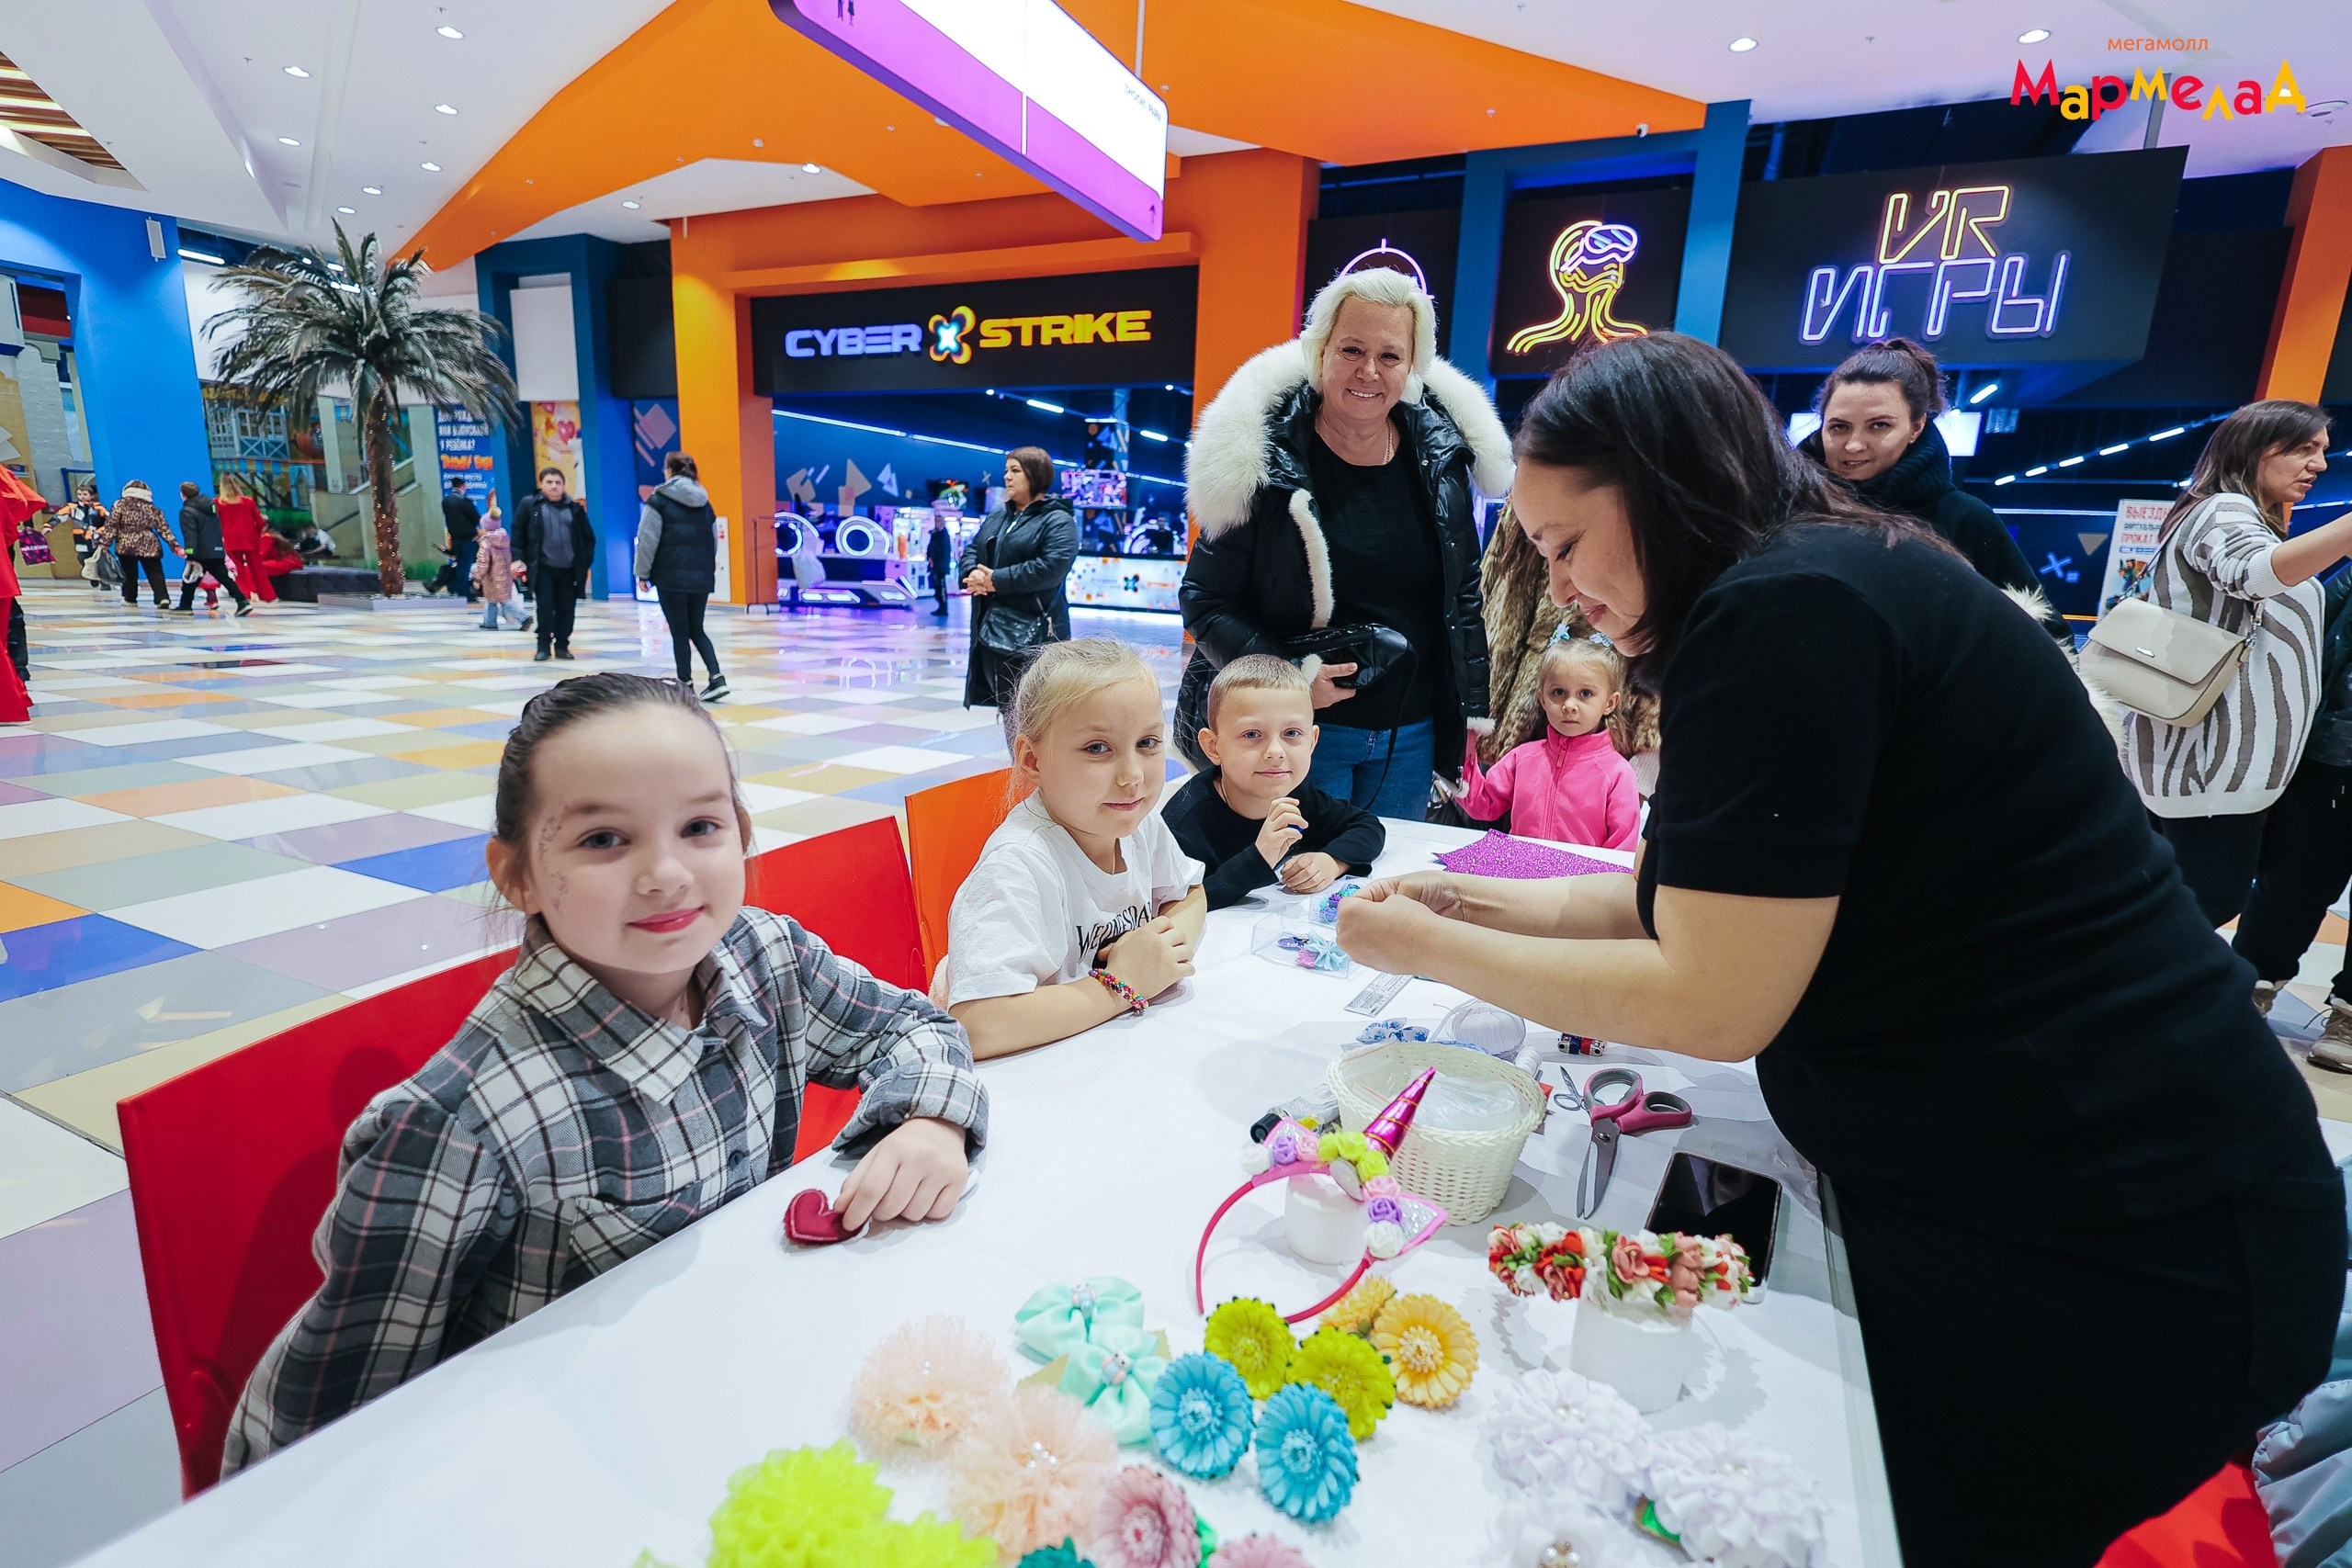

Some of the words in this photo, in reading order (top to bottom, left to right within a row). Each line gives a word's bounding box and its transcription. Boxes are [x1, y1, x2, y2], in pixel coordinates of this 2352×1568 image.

[1878, 184, 2010, 265] VR
[785, 323, 923, 357] CYBER
[978, 310, 1152, 348] STRIKE
[1802, 253, 2067, 341] ИГРЫ
